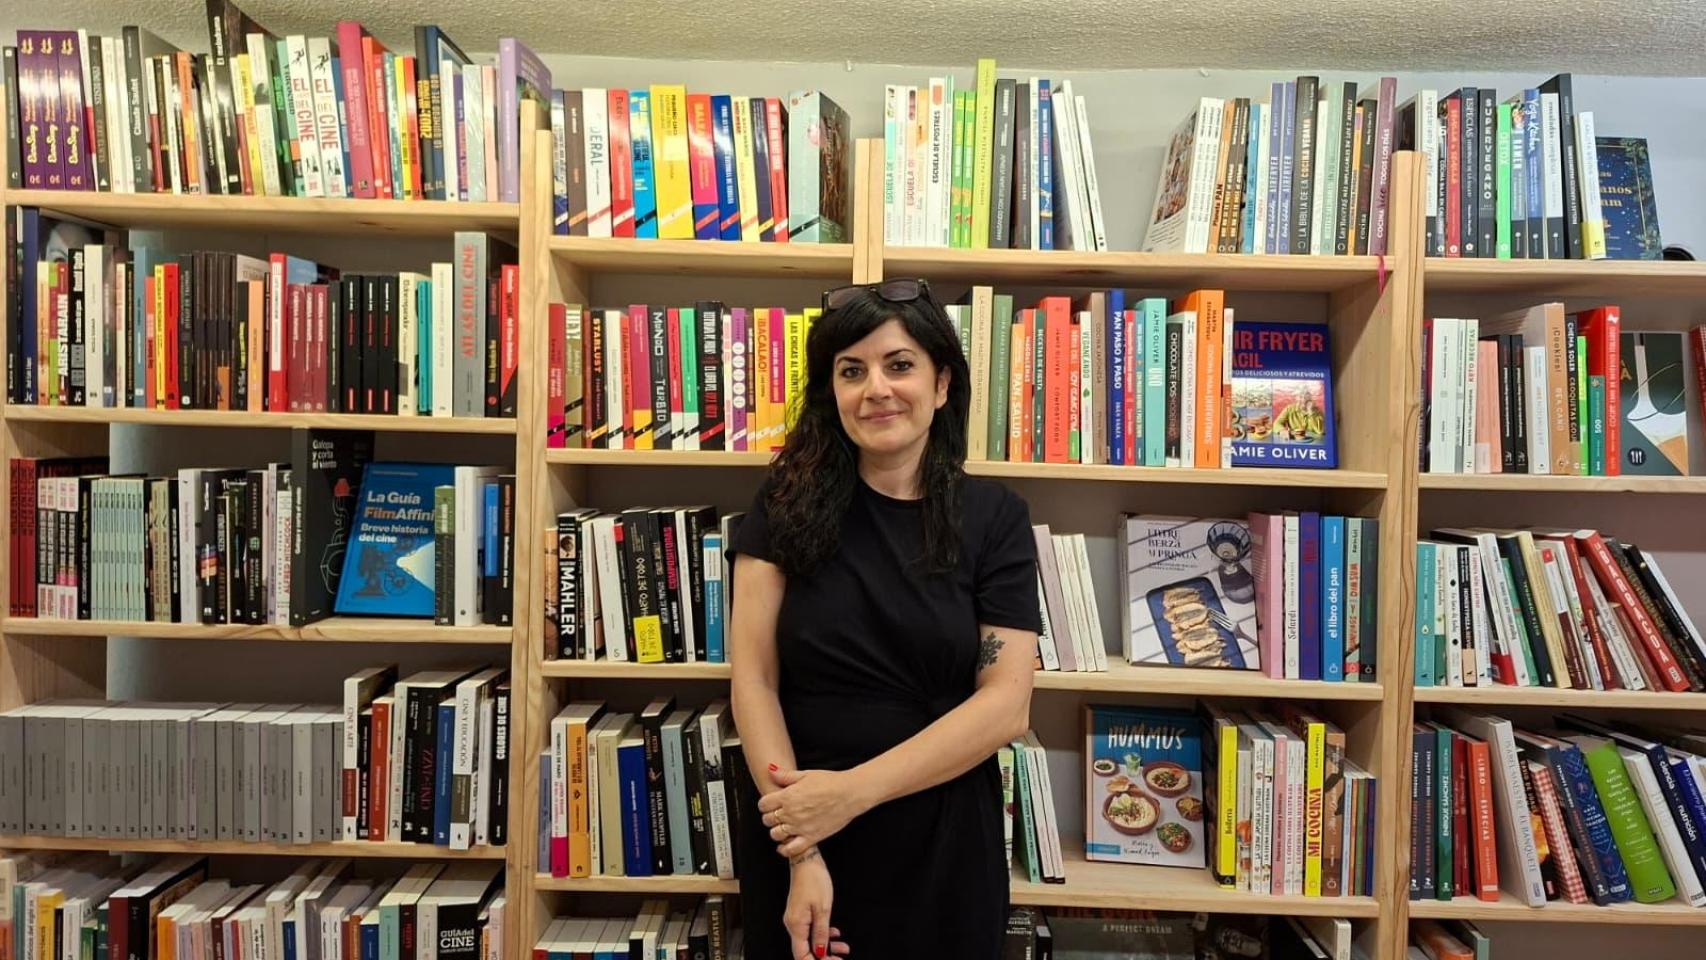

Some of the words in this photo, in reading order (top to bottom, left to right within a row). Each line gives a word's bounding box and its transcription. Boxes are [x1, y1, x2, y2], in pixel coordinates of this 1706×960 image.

[131, 78, 139, 105] Sautet
[133, 107, 142, 135] Claude
[297, 109, 314, 142] CINE
[933, 111, 941, 142] POSTRES
[1465, 97, 1474, 138] ESPECIAS
[320, 115, 339, 150] CINE
[1301, 119, 1311, 148] VEGANA
[1380, 128, 1390, 146] DÍAS
[1380, 146, 1389, 160] LOS
[1484, 98, 1492, 200] SUPERVEGANO
[1500, 132, 1509, 165] DETOX
[932, 152, 940, 184] ESCUELA
[1300, 149, 1310, 178] COCINA
[1379, 161, 1388, 185] TODOS
[1214, 184, 1224, 201] PAN
[1300, 180, 1309, 189] LA
[1300, 191, 1308, 201] DE
[1299, 203, 1308, 226] BIBLIA
[1376, 209, 1384, 239] COCINA
[1299, 228, 1307, 237] LA
[461, 244, 474, 280] CINE
[462, 285, 474, 311] DEL
[790, 322, 798, 334] LAS
[1113, 311, 1123, 331] PAN
[58, 293, 68, 376] ARISTARAIN
[461, 314, 474, 359] ATLAS
[593, 318, 602, 373] STARLUST
[757, 318, 767, 372] ¡BACALAO!
[790, 335, 798, 359] CHICAS
[1113, 331, 1122, 356] PASO
[1233, 330, 1253, 350] IR
[1259, 331, 1323, 352] FRYER
[1468, 329, 1476, 361] RECETAS
[1567, 322, 1576, 349] CHEMA
[790, 360, 798, 368] AL
[1114, 356, 1122, 364] A
[1169, 332, 1178, 380] CHOCOLATE
[1568, 349, 1577, 372] SOLER
[1013, 372, 1022, 396] PAN
[1114, 365, 1123, 389] PASO
[1148, 367, 1163, 387] UNO
[1244, 369, 1284, 378] DELICIOSOS
[1569, 376, 1578, 421] CROQUETAS
[1013, 402, 1022, 439] SALUD
[1594, 419, 1602, 434] 500
[1232, 445, 1265, 458] AMIE
[1271, 446, 1328, 460] OLIVER
[368, 490, 385, 503] La
[387, 490, 421, 503] Guía
[364, 506, 435, 522] FilmAffini
[359, 534, 376, 543] del
[376, 534, 397, 544] cine
[360, 523, 390, 533] Breve
[391, 523, 429, 535] historia
[664, 527, 676, 590] COMPOSITORAS
[1331, 567, 1340, 586] pan
[560, 567, 574, 635] MAHLER
[1329, 587, 1337, 604] del
[1329, 604, 1337, 627] libro
[1329, 629, 1337, 638] el
[461, 698, 470, 717] CINE
[496, 695, 507, 715] CINE
[496, 715, 507, 725] DE
[496, 726, 507, 760] COLORES
[1107, 725, 1187, 750] HUMMUS
[1477, 758, 1486, 785] LIBRO
[1660, 760, 1676, 790] ciencia
[1441, 775, 1450, 806] SÁNCHEZ
[1224, 808, 1233, 835] Bollería
[1308, 787, 1321, 838] COCINA
[1442, 807, 1450, 836] ENRIQUE
[1480, 799, 1490, 841] ESPECIAS
[1678, 805, 1698, 842] nutrición
[1308, 841, 1320, 857] MI
[27, 908, 35, 924] siglo
[712, 910, 720, 945] BEATLES
[26, 925, 34, 936] del
[440, 937, 475, 949] CINE
